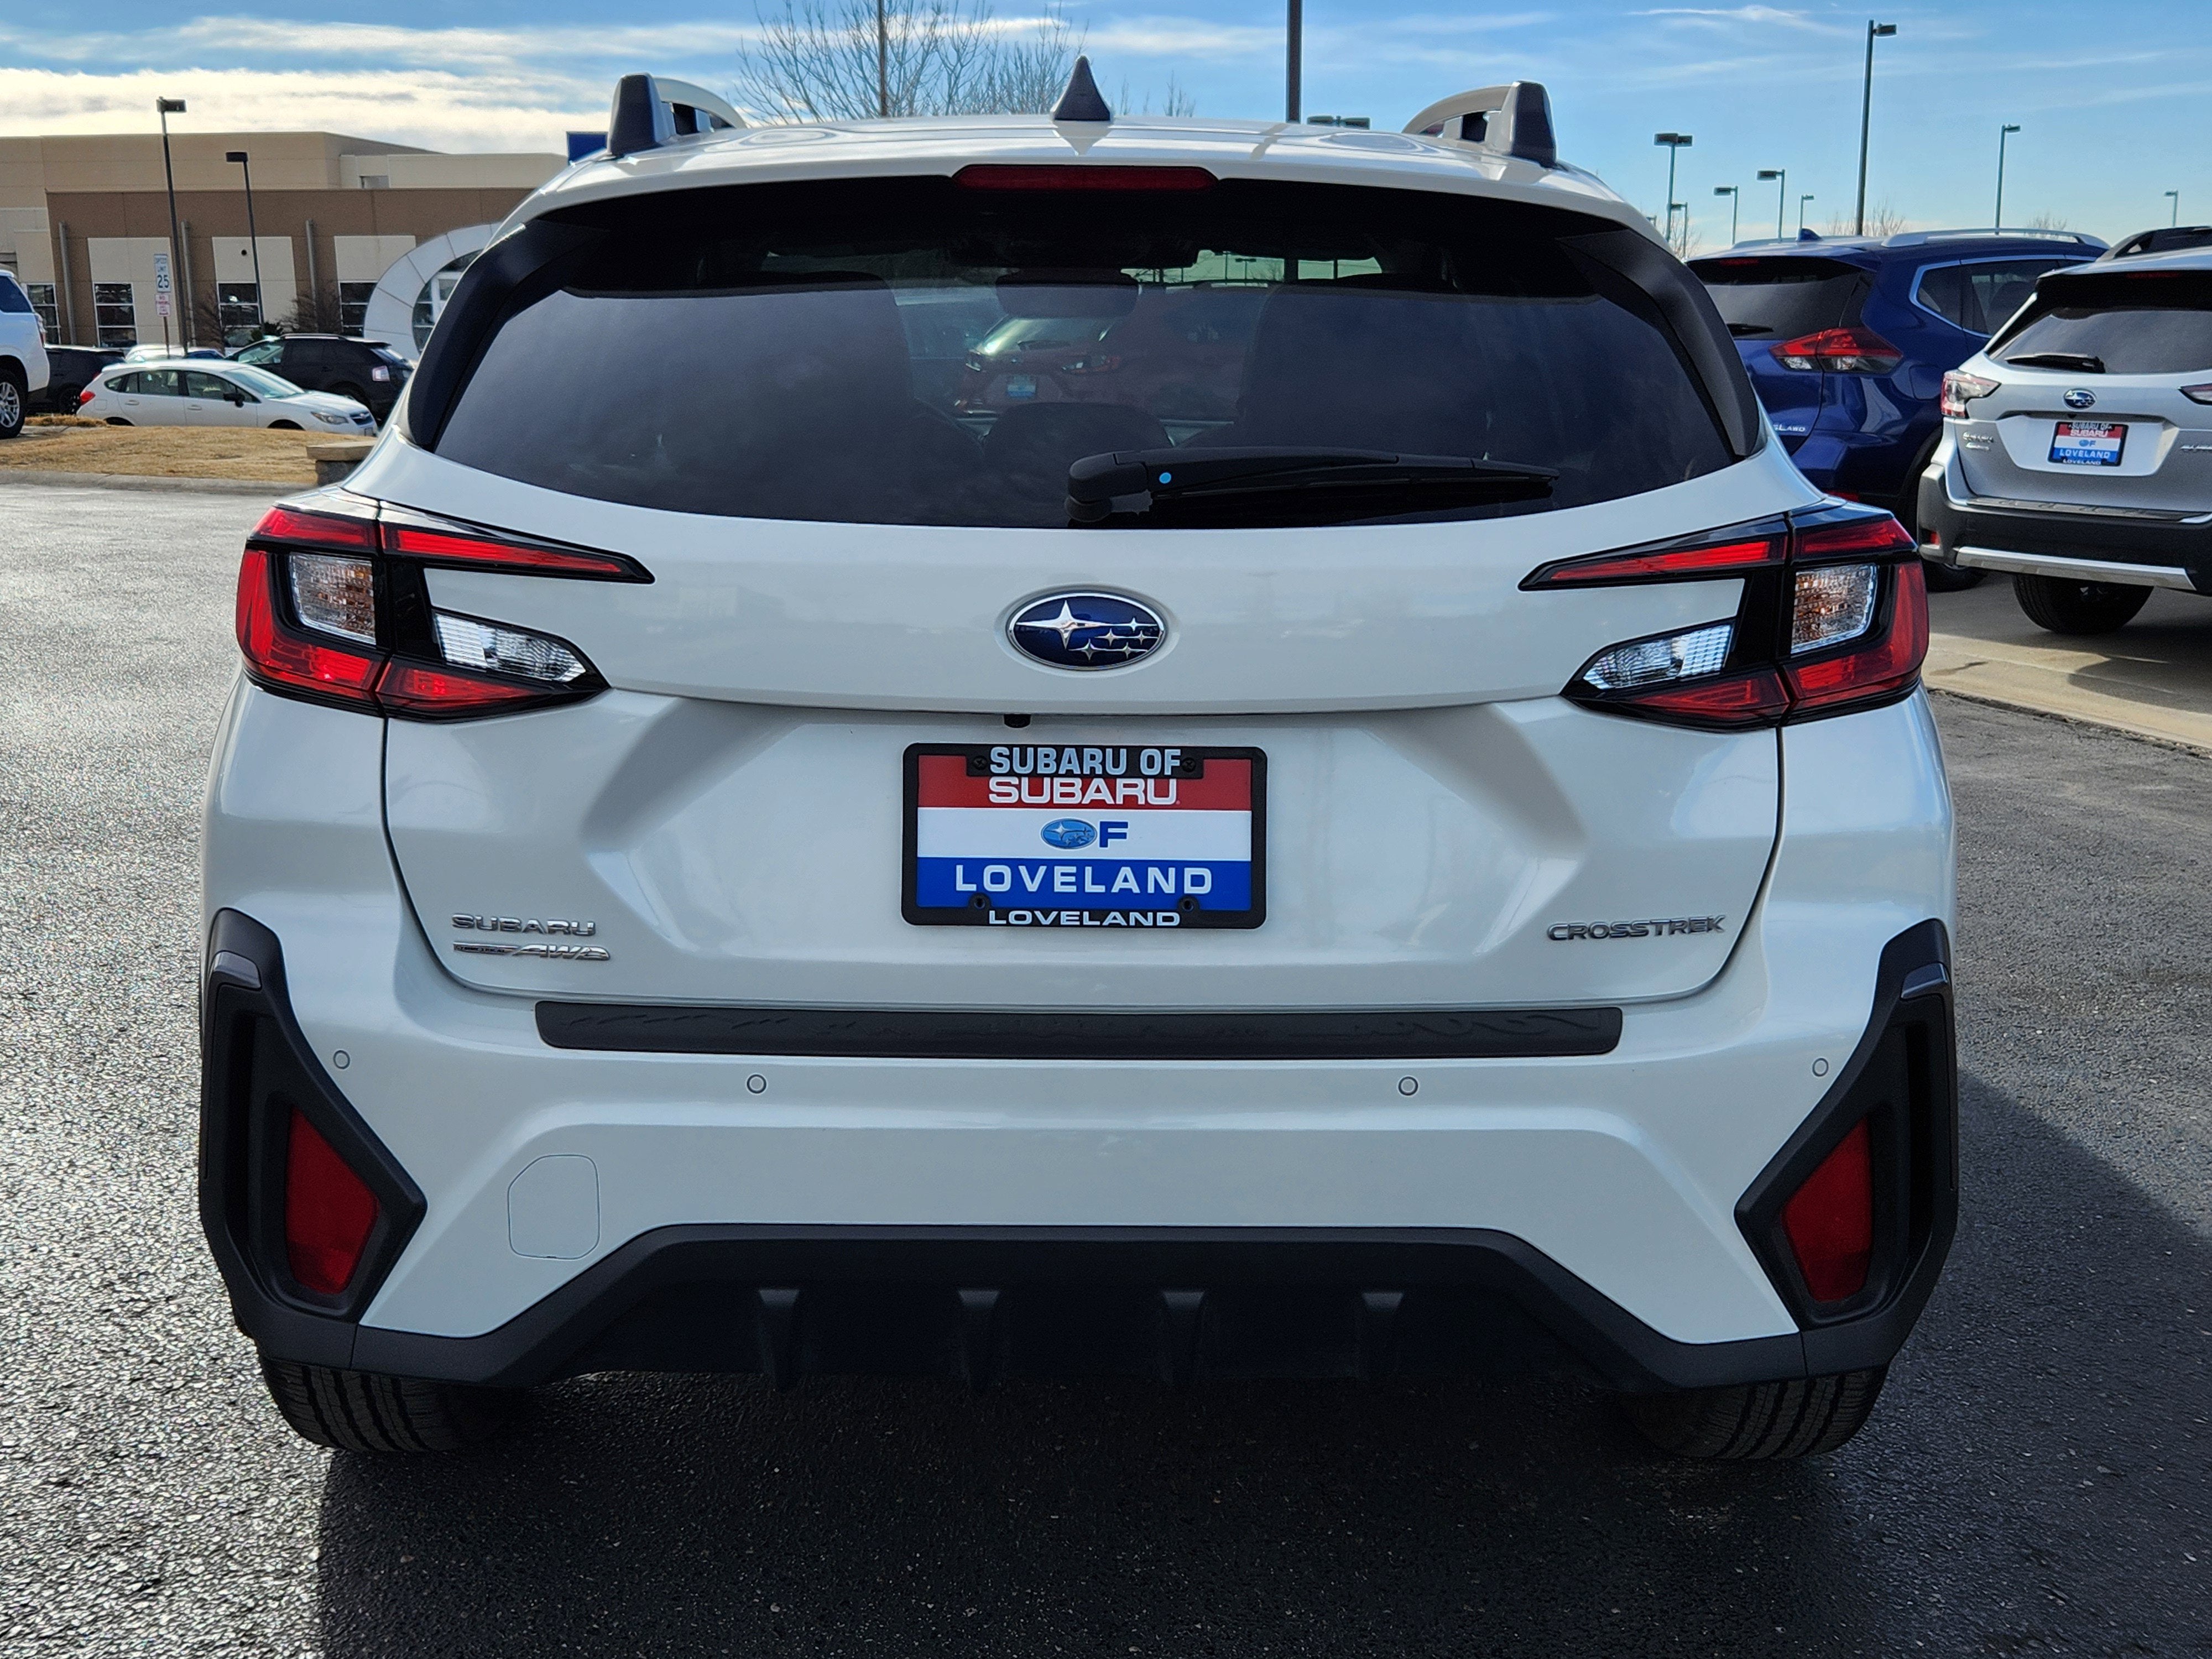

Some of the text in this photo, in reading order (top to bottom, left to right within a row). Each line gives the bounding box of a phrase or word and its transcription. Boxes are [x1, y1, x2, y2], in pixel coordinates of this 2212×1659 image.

[157, 275, 169, 288] 25
[2070, 429, 2108, 437] SUBARU
[2059, 448, 2110, 459] LOVELAND
[990, 747, 1181, 775] SUBARU OF
[988, 776, 1177, 805] SUBARU
[956, 864, 1212, 894] LOVELAND
[451, 914, 596, 936] SUBARU
[989, 910, 1180, 926] LOVELAND
[1547, 914, 1726, 941] CROSSTREK
[512, 943, 611, 961] AWD
